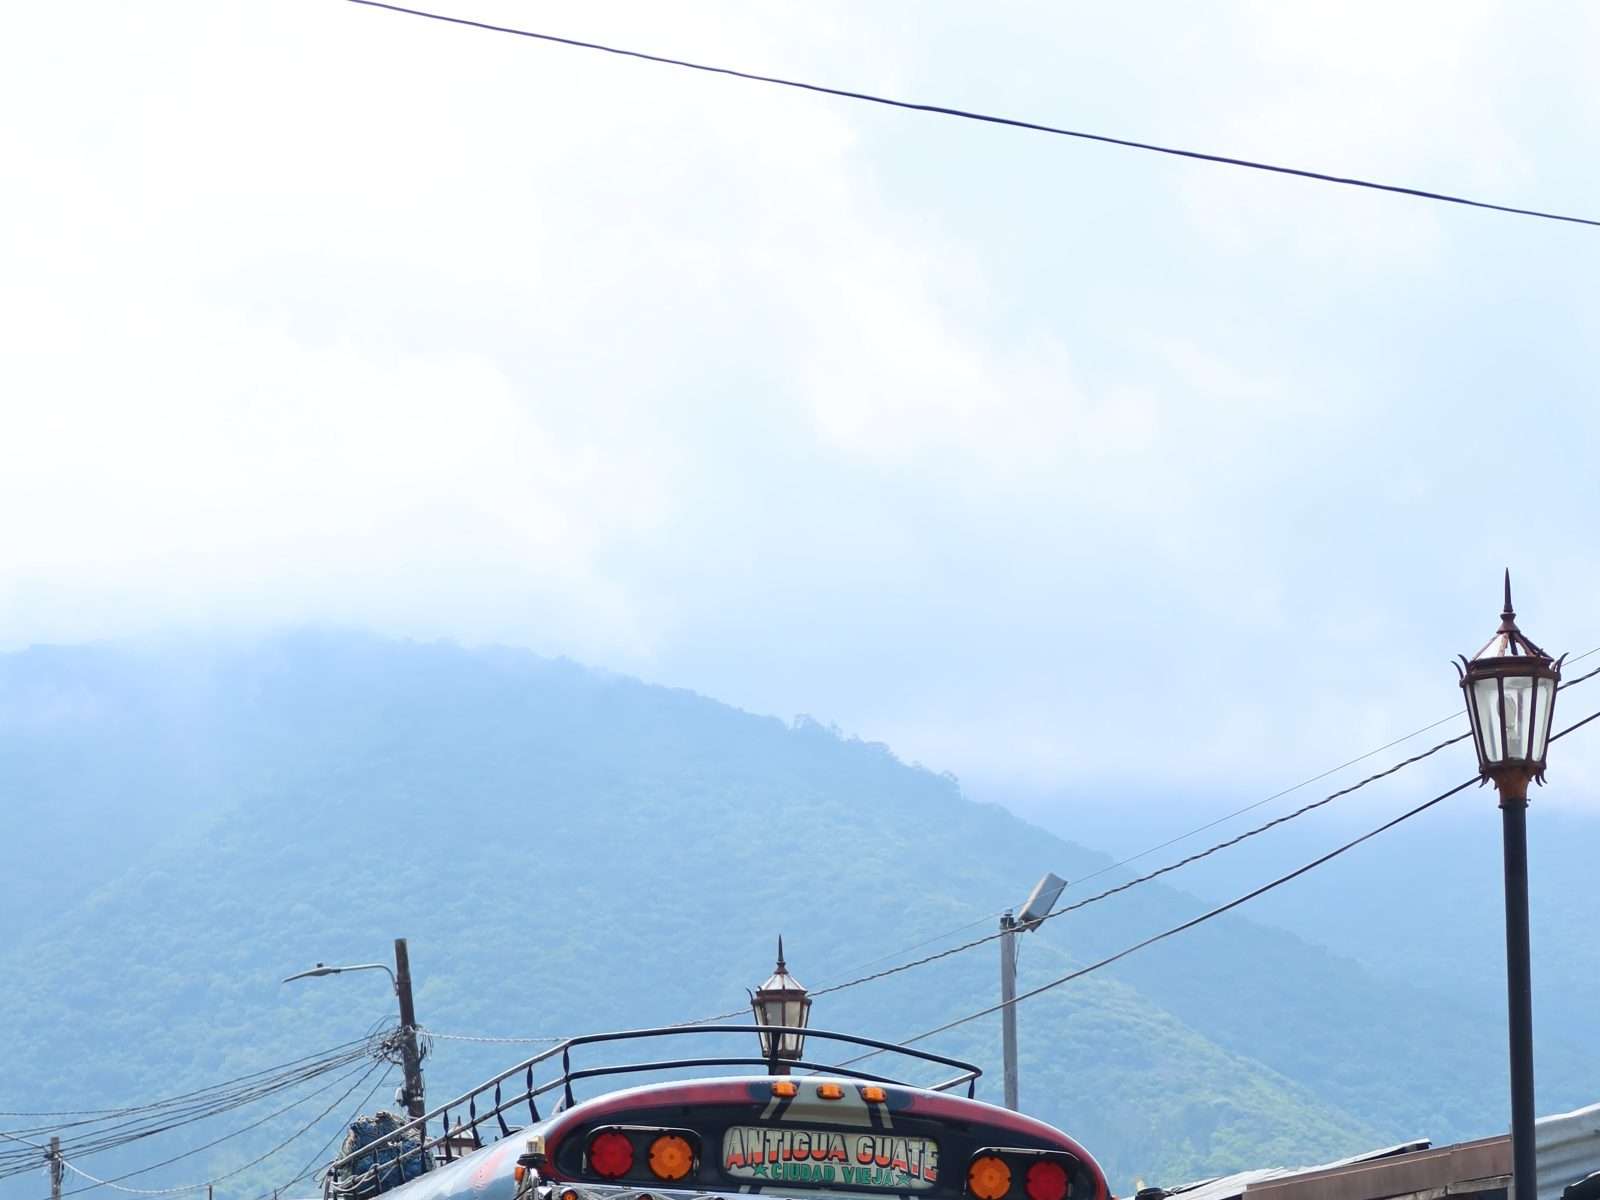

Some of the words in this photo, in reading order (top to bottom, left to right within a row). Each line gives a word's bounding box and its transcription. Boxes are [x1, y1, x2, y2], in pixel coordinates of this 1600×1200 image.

[726, 1127, 849, 1170] ANTIGUA
[857, 1135, 939, 1183] GUATE
[771, 1163, 835, 1183] CIUDAD
[842, 1167, 894, 1186] VIEJA
